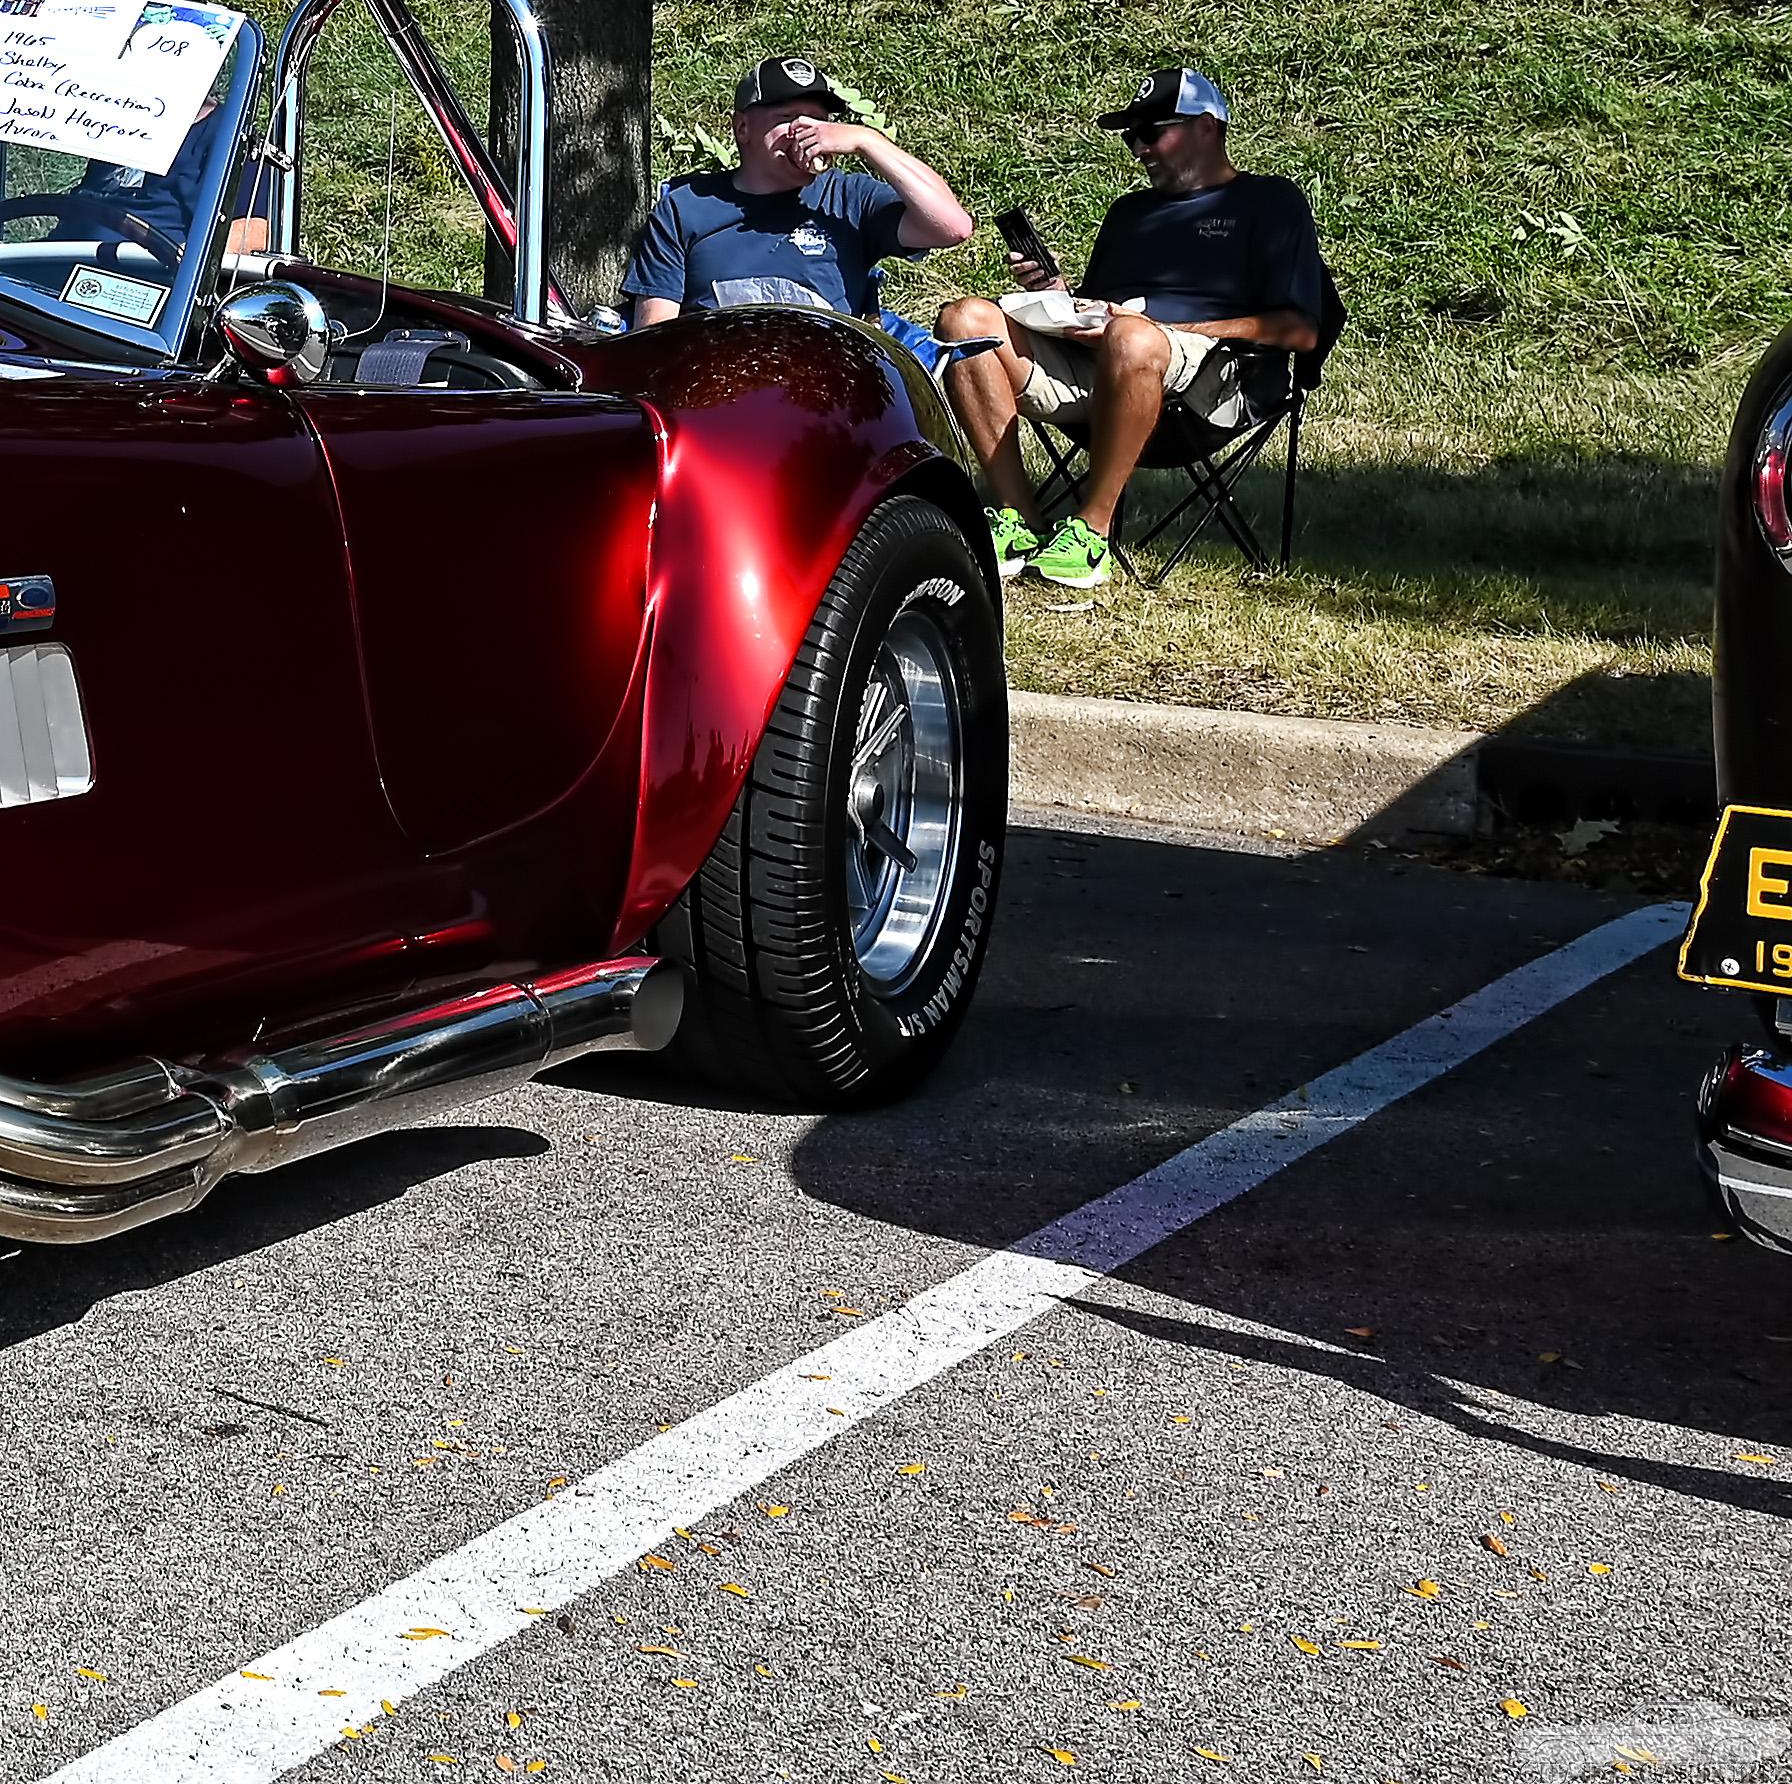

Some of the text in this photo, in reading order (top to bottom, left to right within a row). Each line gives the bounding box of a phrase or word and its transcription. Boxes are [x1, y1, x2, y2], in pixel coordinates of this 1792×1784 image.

[3, 31, 57, 47] 1965
[147, 35, 190, 57] 108
[922, 839, 996, 1027] SPORTSMAN
